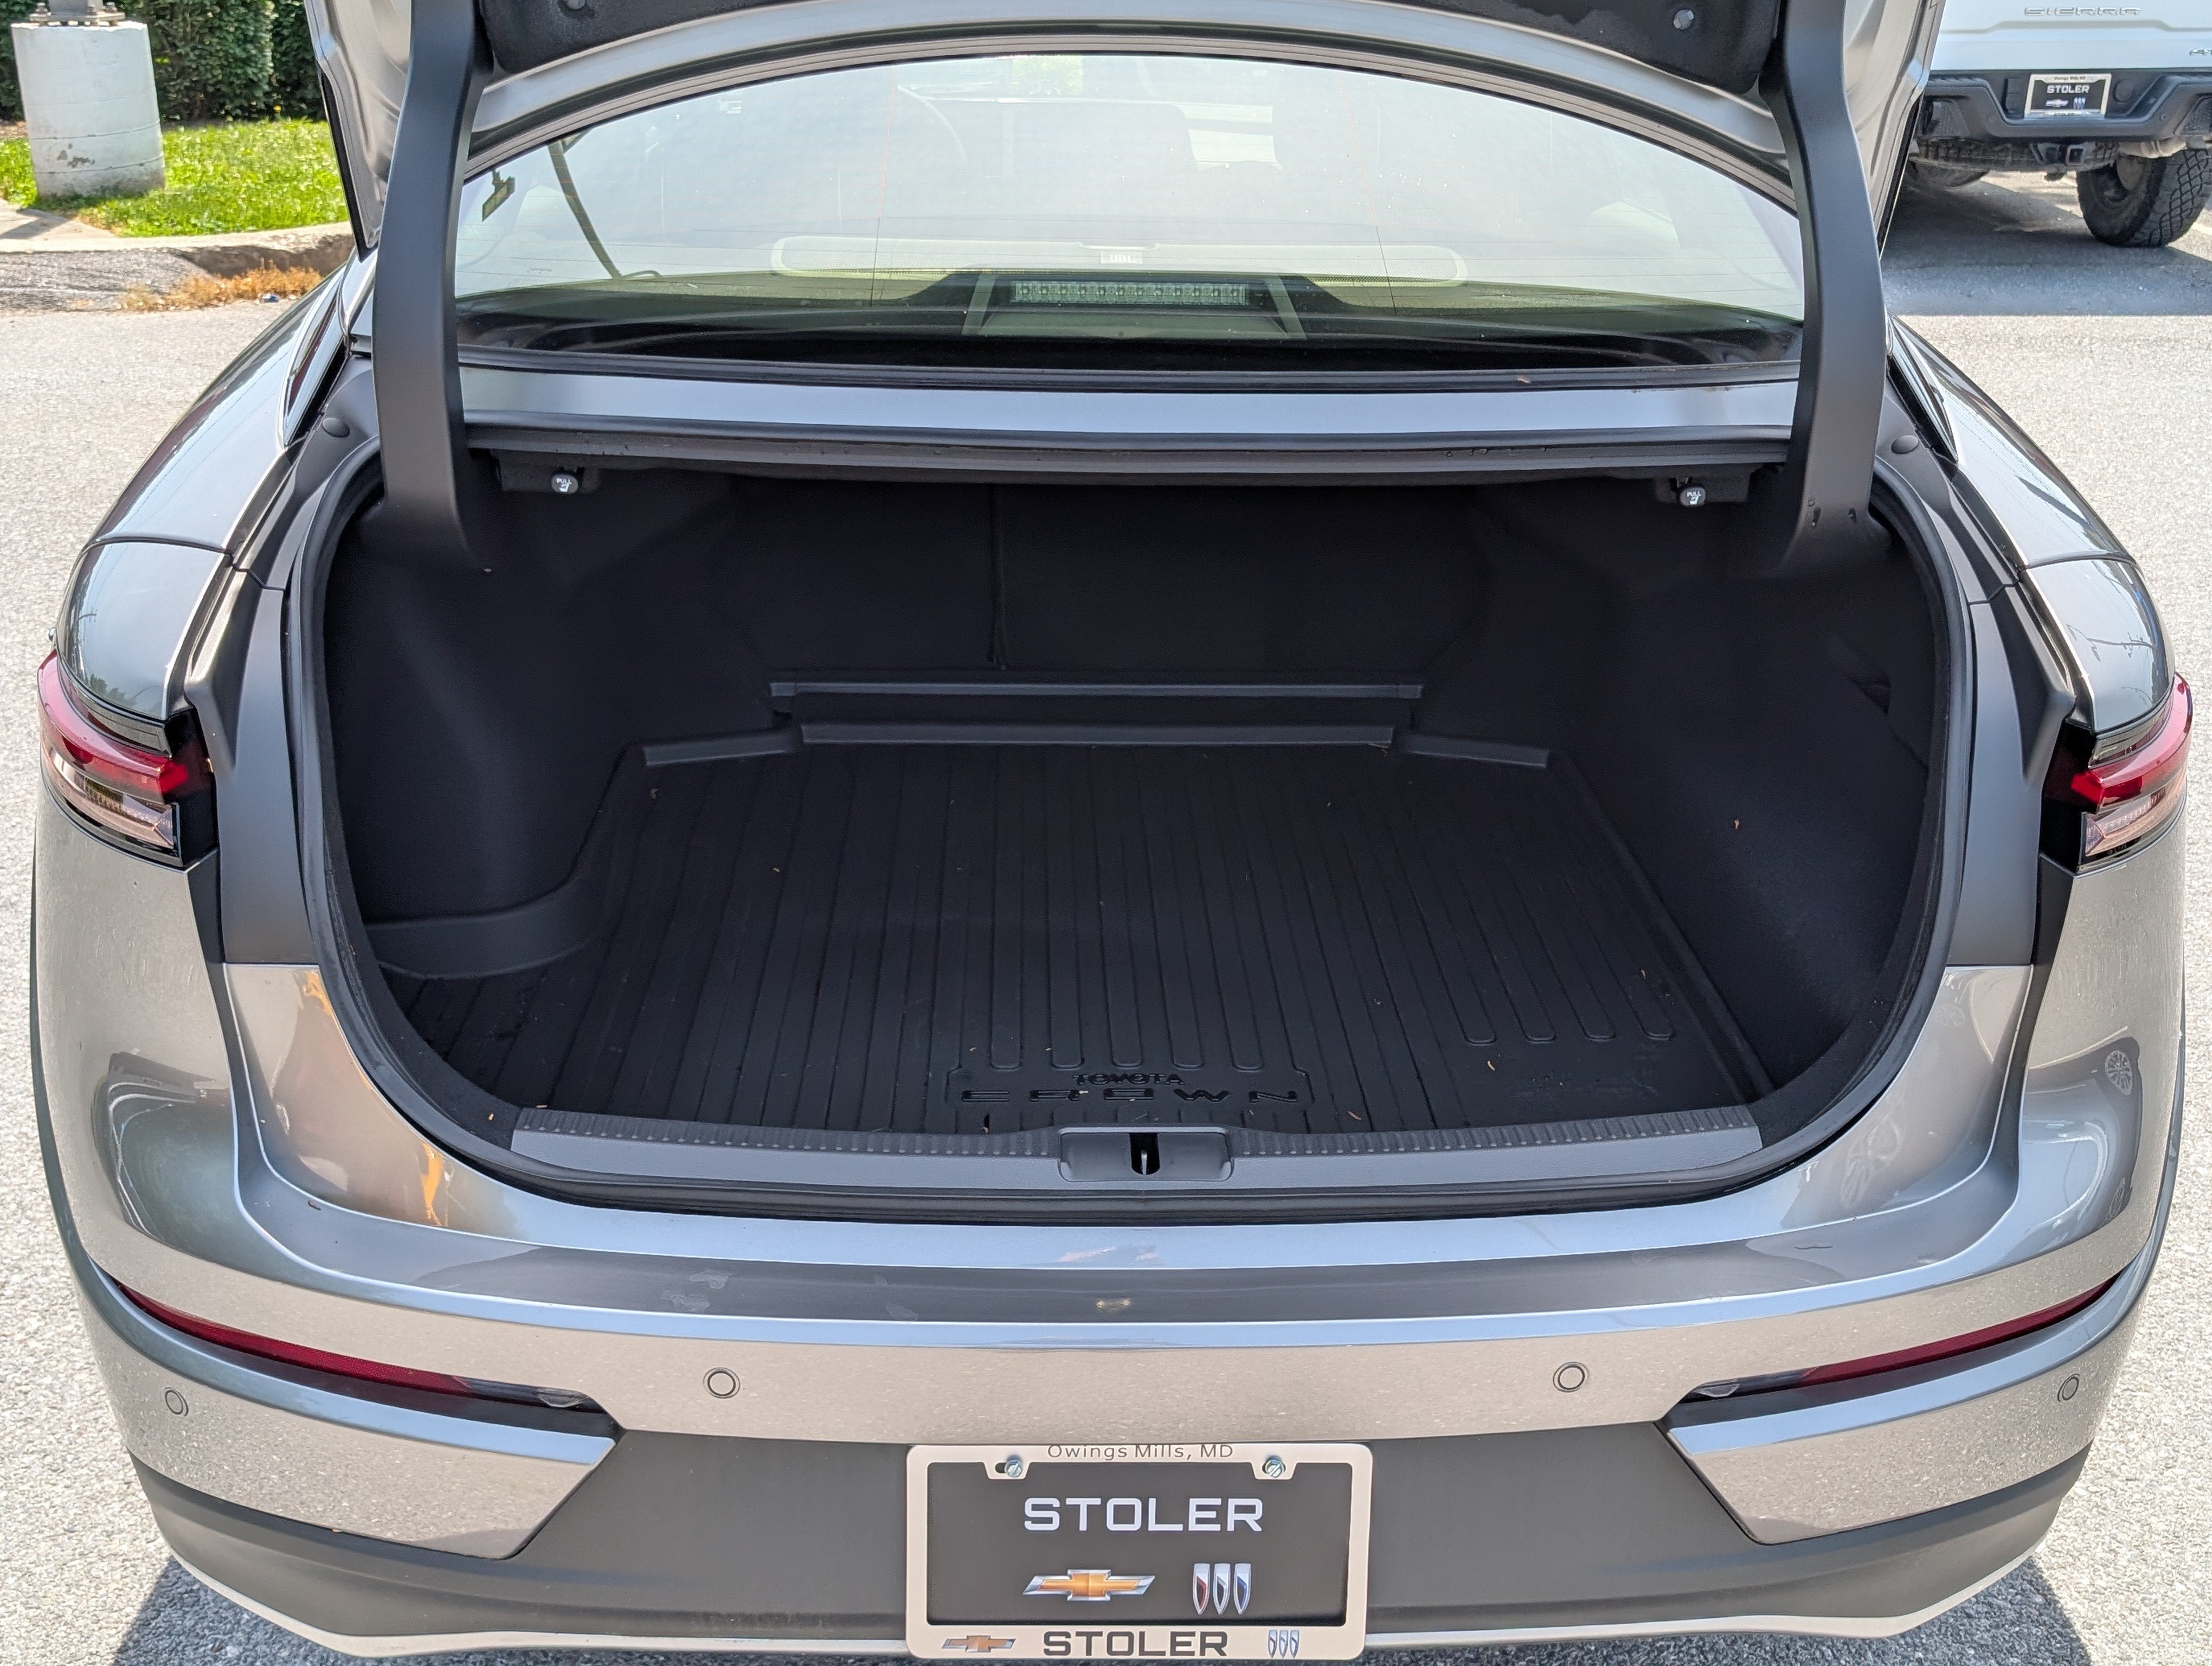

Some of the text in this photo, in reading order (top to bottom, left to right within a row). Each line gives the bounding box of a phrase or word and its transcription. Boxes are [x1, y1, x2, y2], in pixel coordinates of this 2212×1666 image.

[2024, 7, 2141, 16] SIERRA
[2047, 85, 2090, 94] STOLER
[1073, 1073, 1185, 1085] TOYOTA
[961, 1087, 1297, 1103] CROWN
[1047, 1444, 1233, 1460] Owings Mills, MD
[1024, 1498, 1263, 1532] STOLER
[1044, 1631, 1228, 1656] STOLER
